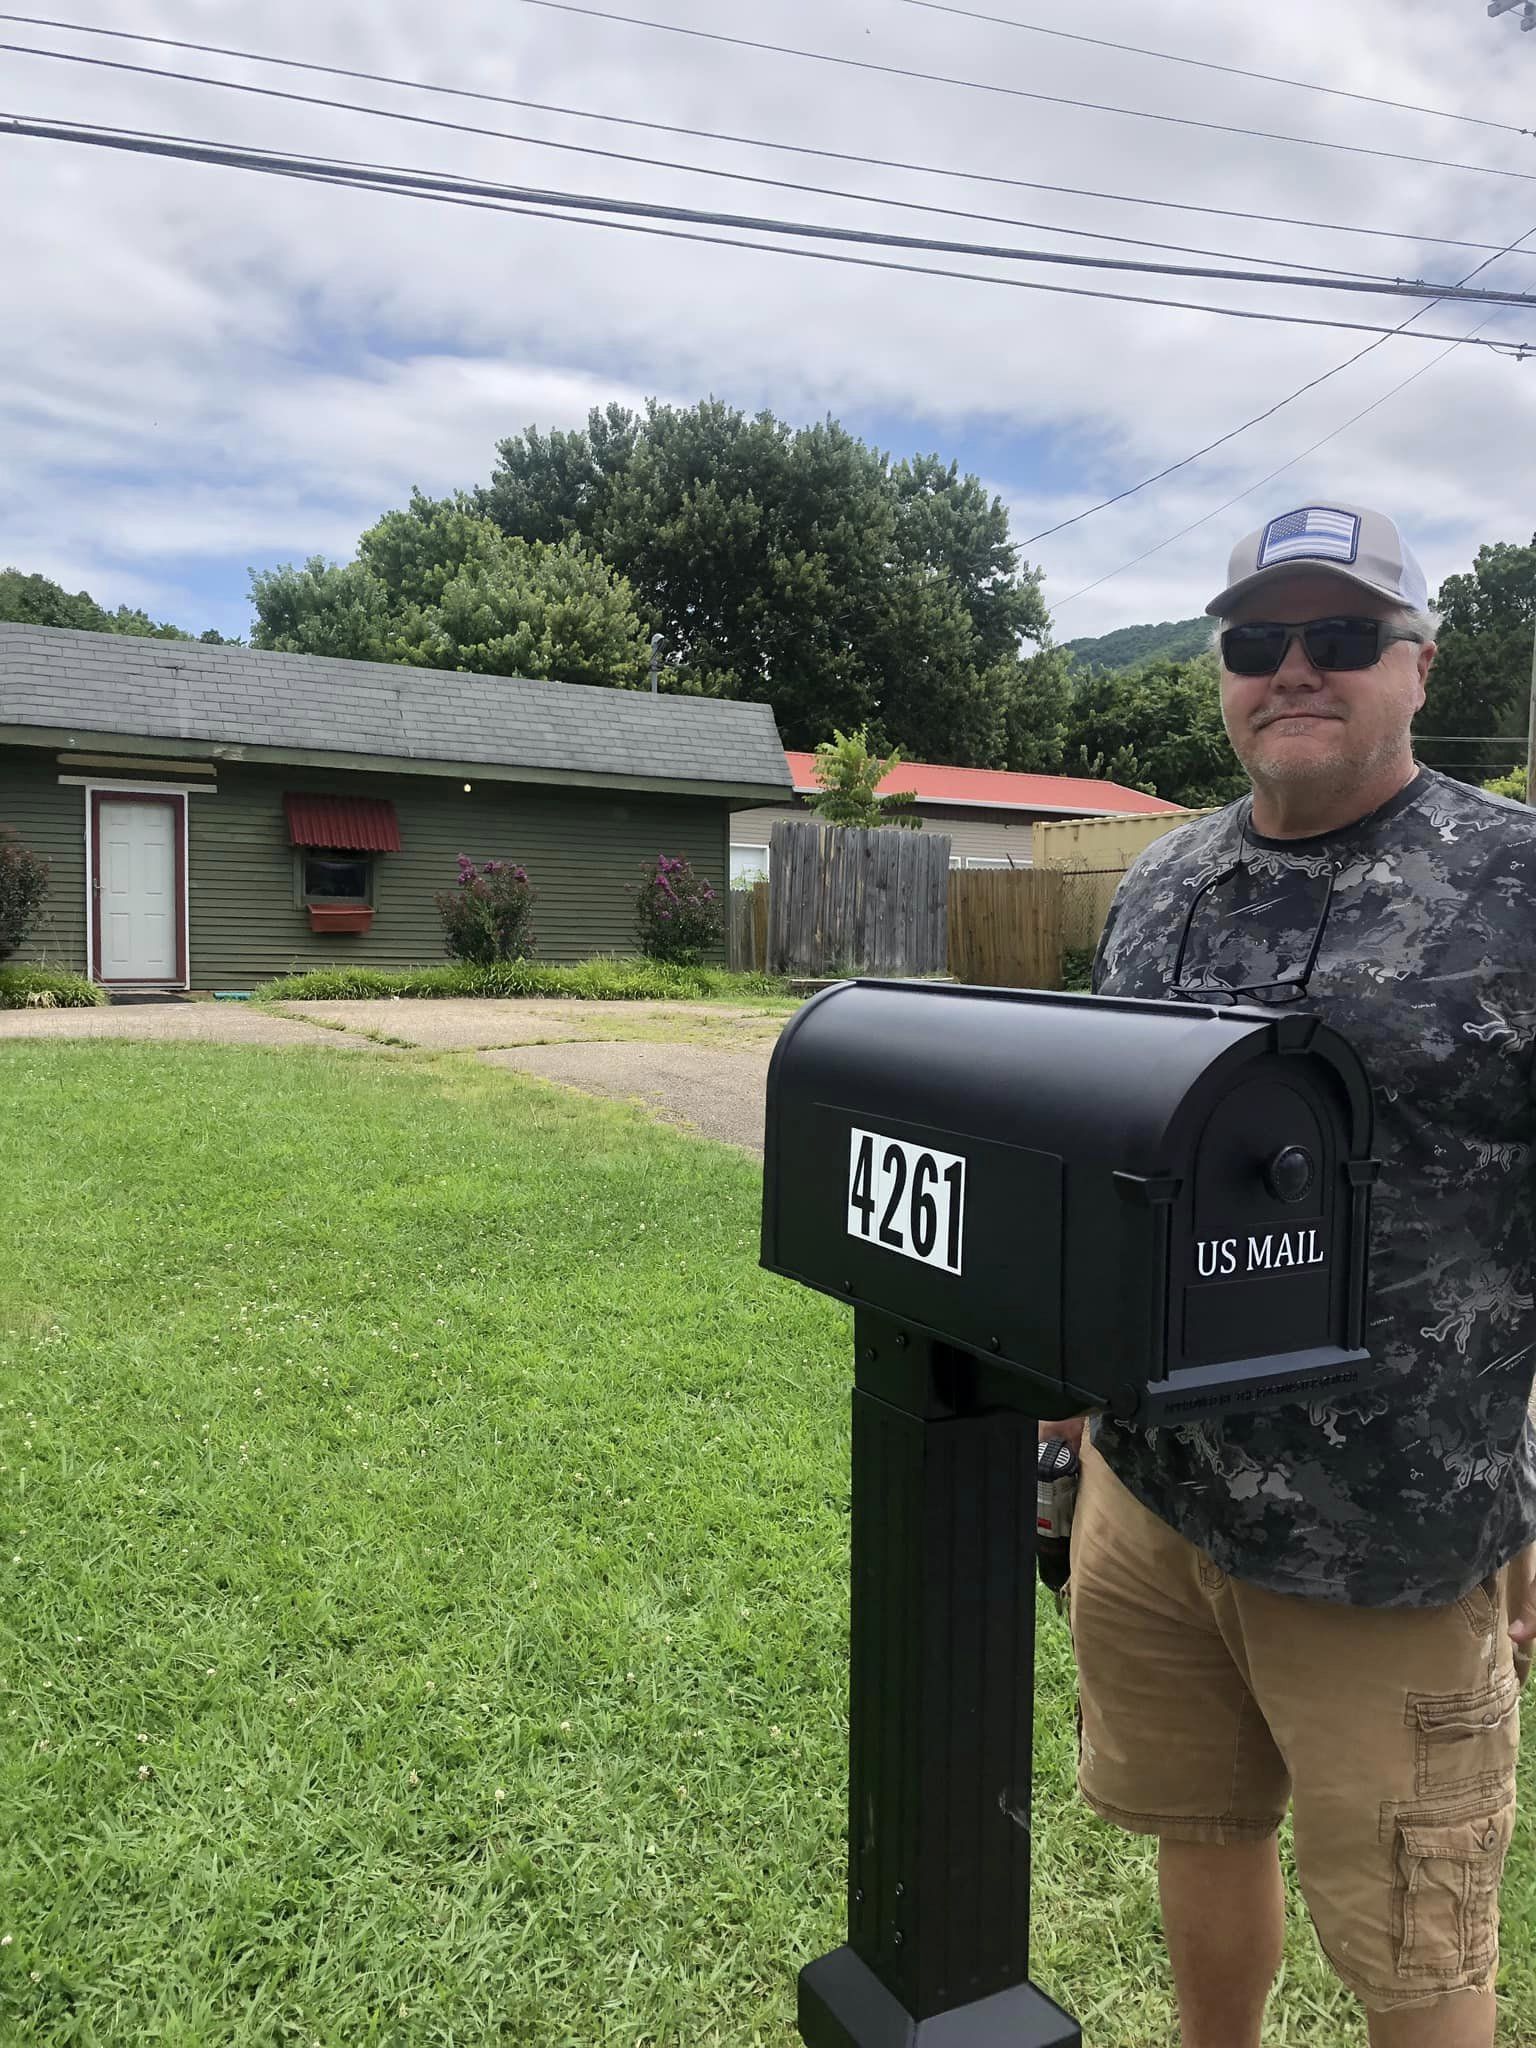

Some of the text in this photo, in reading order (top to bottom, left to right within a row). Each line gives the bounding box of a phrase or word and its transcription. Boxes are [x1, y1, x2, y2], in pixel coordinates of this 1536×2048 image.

[851, 1135, 963, 1270] 4261
[1197, 1229, 1324, 1277] US MAIL
